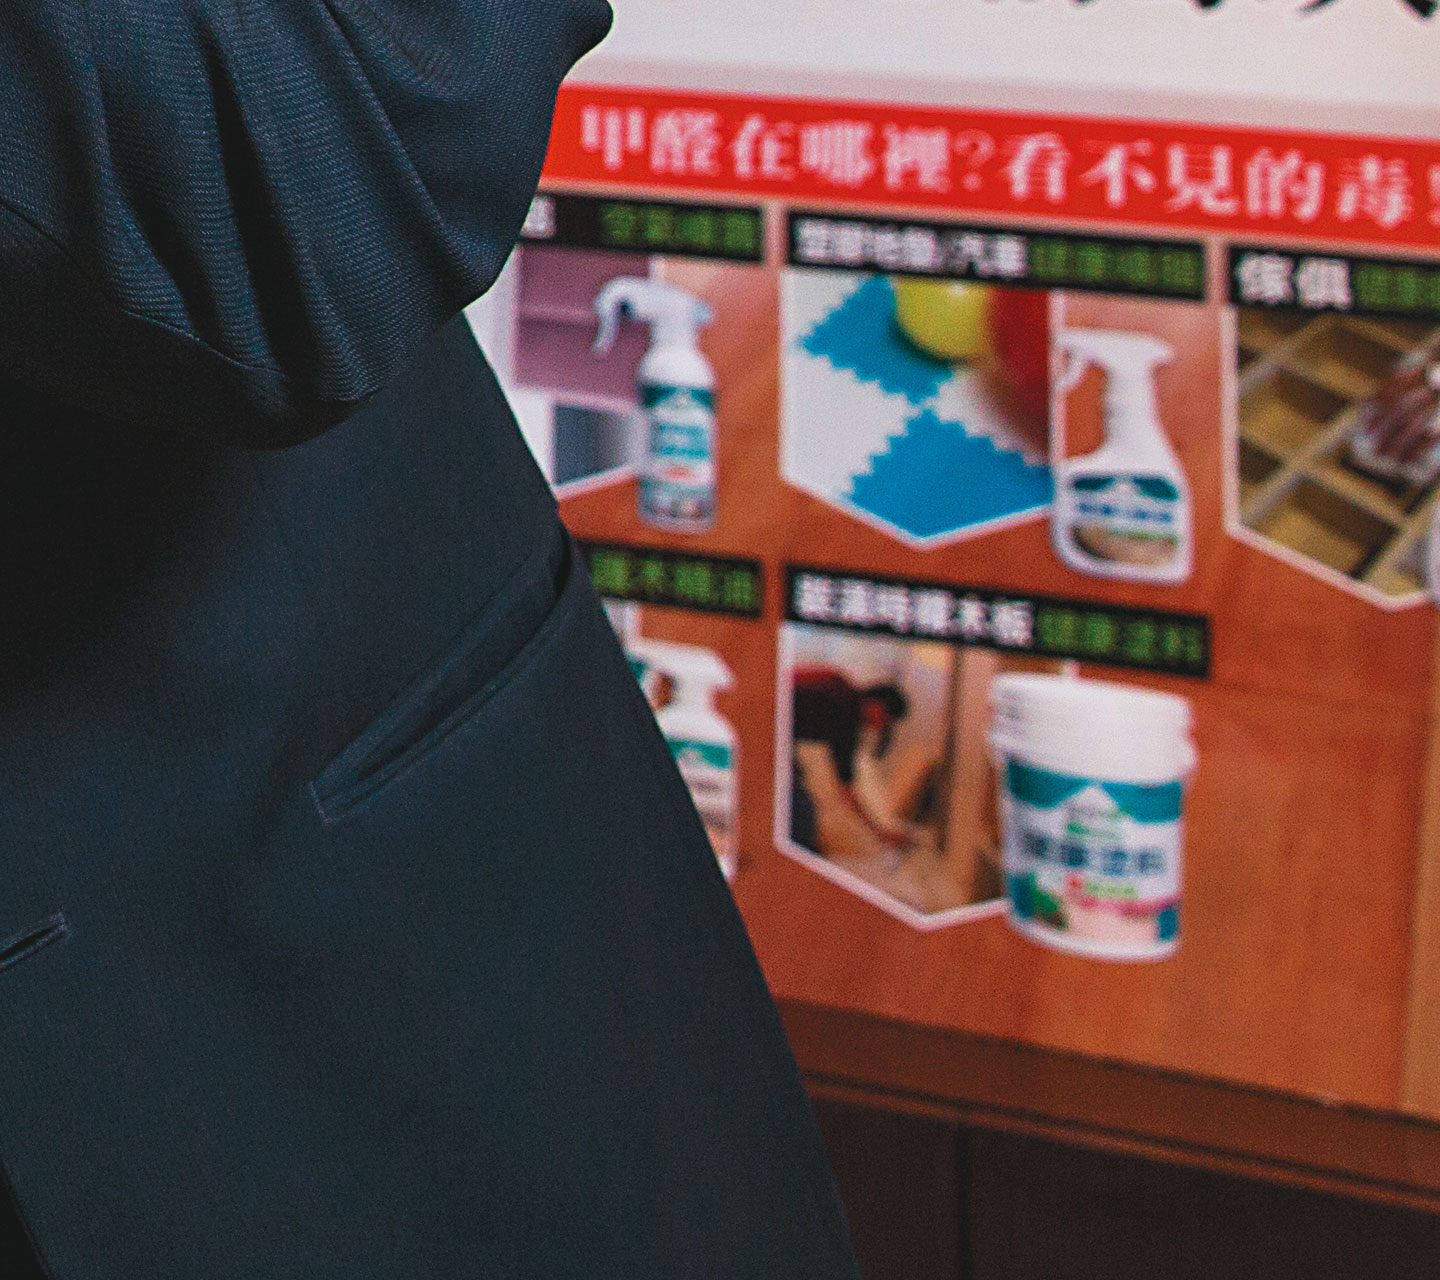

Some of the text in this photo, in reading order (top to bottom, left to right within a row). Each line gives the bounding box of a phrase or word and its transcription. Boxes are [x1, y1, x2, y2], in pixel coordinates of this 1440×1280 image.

[582, 103, 1440, 228] 甲醛在哪裡?看不見的毒
